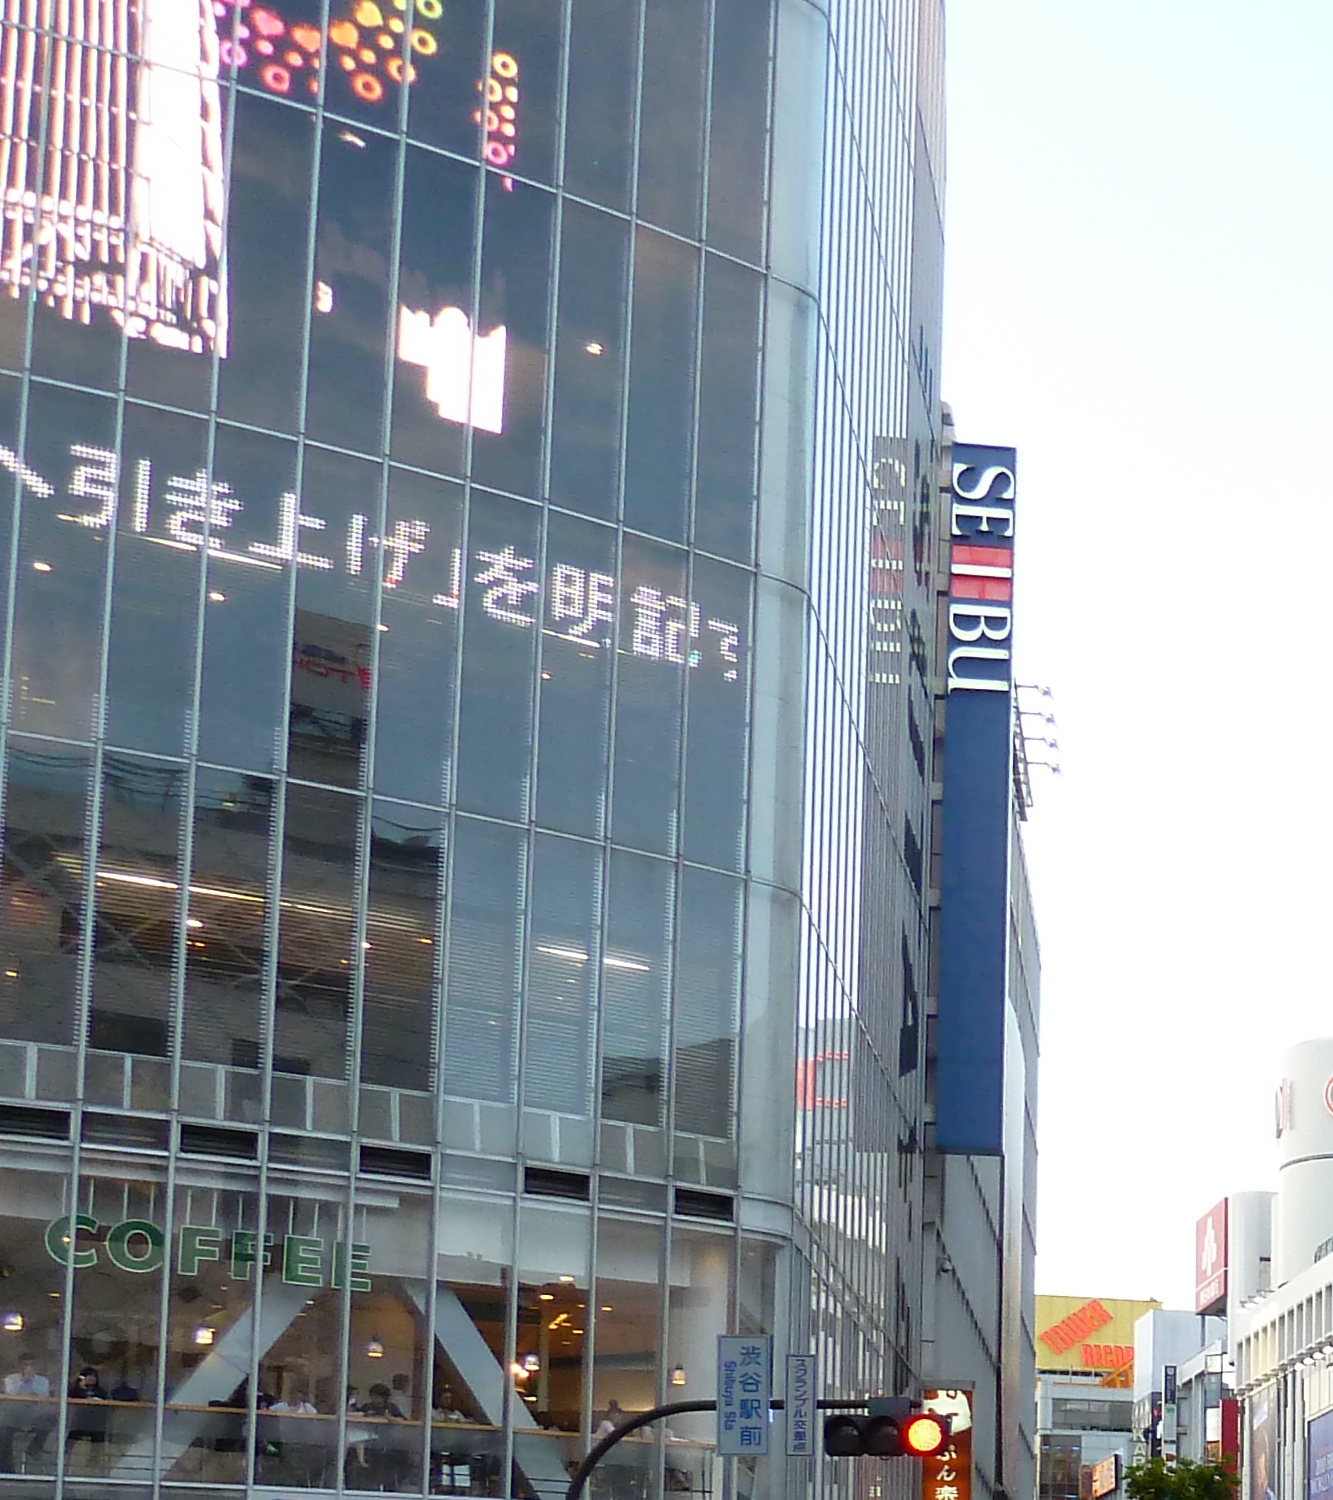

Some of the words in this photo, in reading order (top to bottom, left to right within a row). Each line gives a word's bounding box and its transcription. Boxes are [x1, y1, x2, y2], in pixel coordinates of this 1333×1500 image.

[948, 462, 1015, 694] SEIBU
[44, 1213, 373, 1293] COFFEE
[1040, 1298, 1114, 1356] TOWER
[741, 1345, 762, 1446] 渋谷駅前
